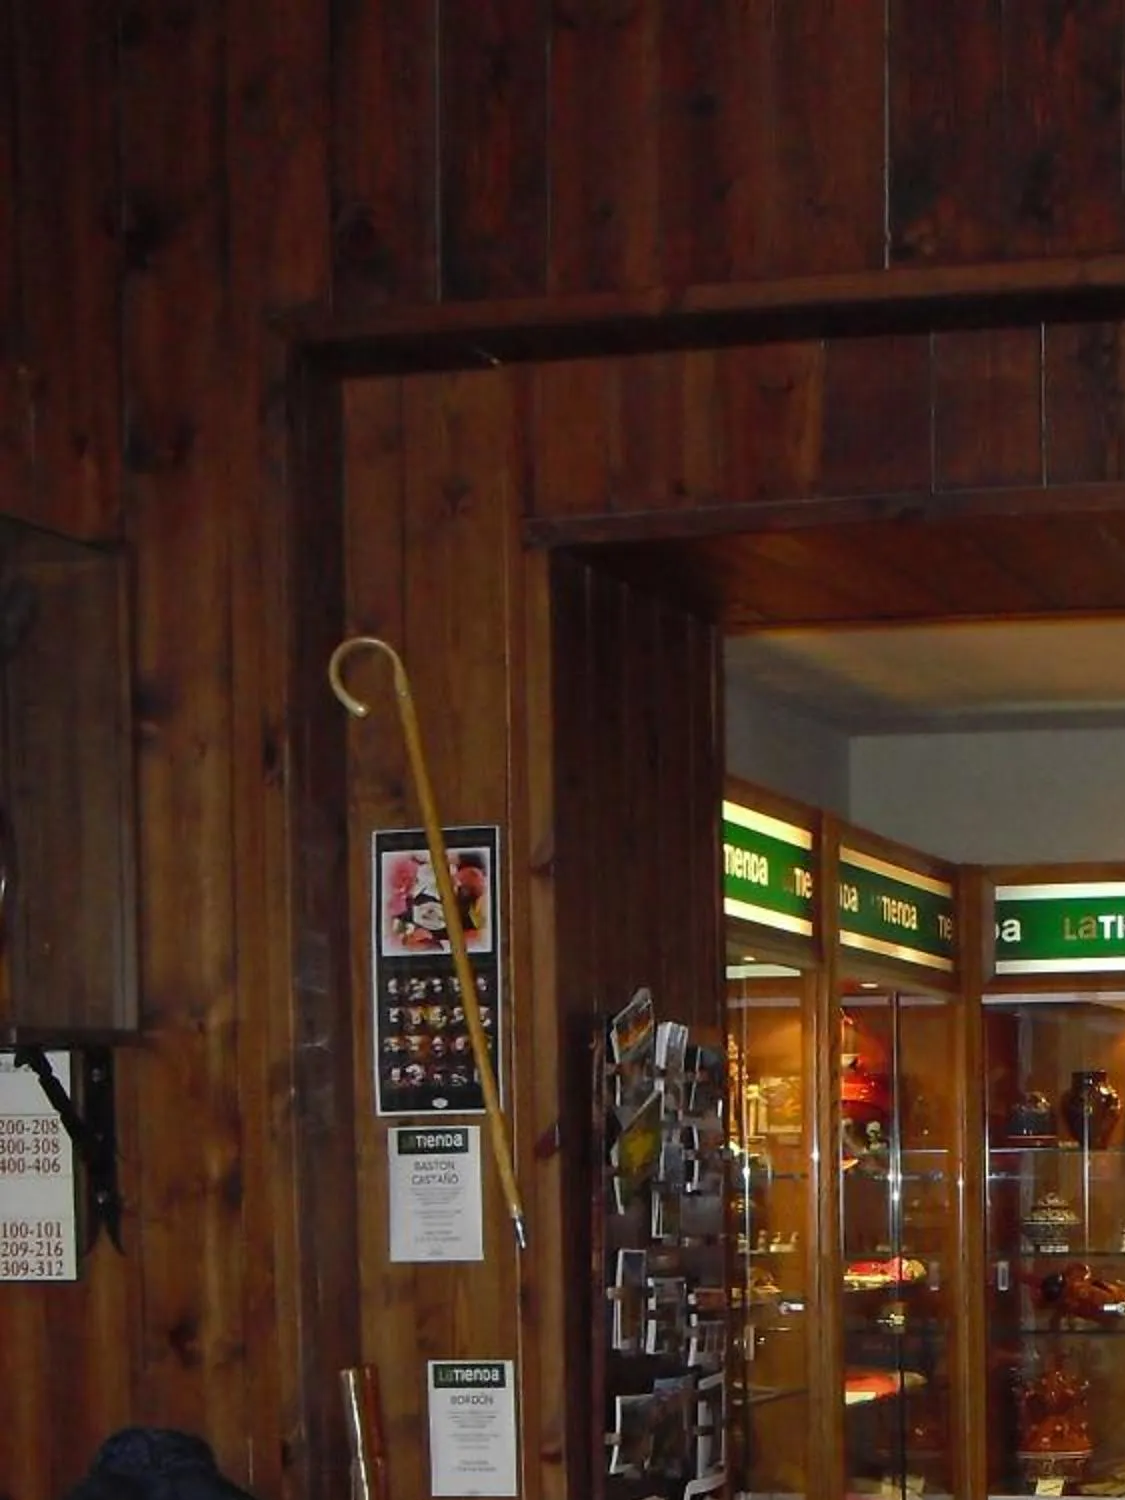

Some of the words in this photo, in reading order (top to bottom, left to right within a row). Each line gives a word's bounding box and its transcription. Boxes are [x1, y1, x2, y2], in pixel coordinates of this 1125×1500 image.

[995, 919, 1021, 943] a
[2, 1221, 62, 1238] 100-101
[1, 1241, 63, 1257] 209-216
[1, 1260, 64, 1277] 309-312
